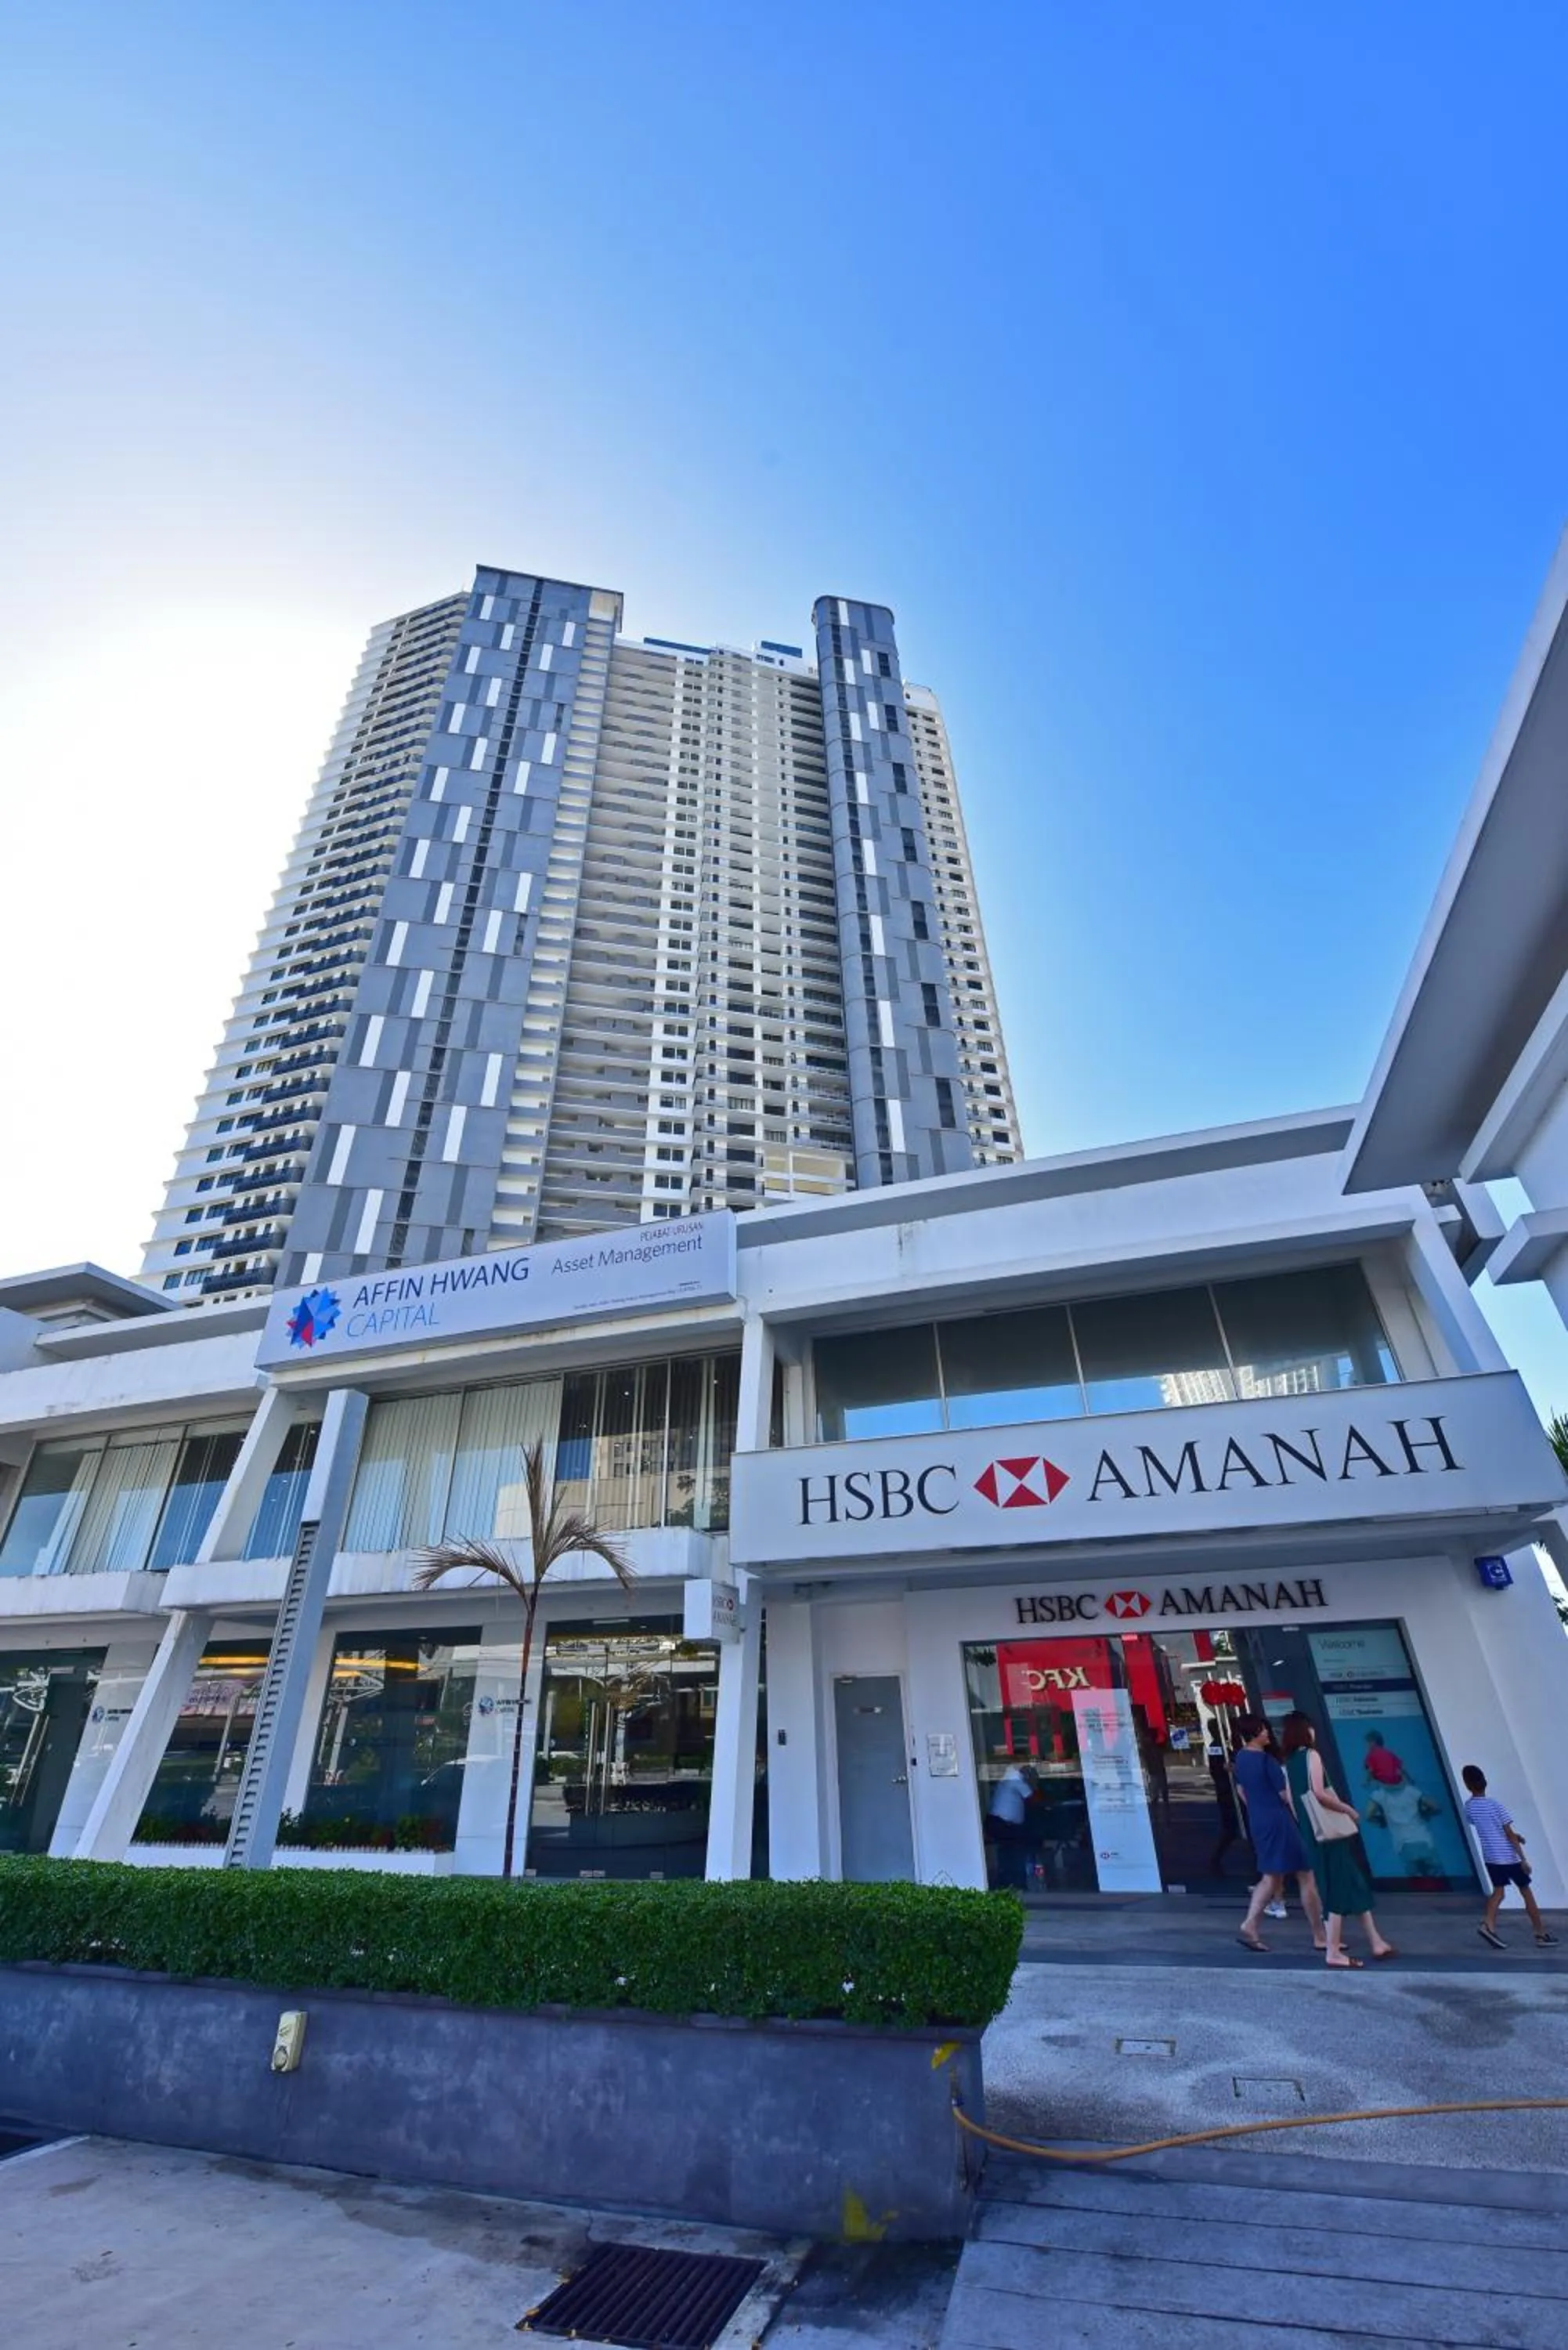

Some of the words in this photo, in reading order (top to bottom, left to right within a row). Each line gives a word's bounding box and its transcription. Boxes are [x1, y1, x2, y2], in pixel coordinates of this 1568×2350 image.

[551, 1255, 594, 1274] Asset
[598, 1235, 703, 1267] Management
[353, 1275, 424, 1308] AFFIN
[430, 1257, 529, 1294] HWANG
[346, 1302, 439, 1338] CAPITAL
[795, 1466, 959, 1525] HSBC
[1087, 1416, 1465, 1502] AMANAH
[1014, 1594, 1099, 1624] HSBC
[1159, 1578, 1329, 1616] AMANAH
